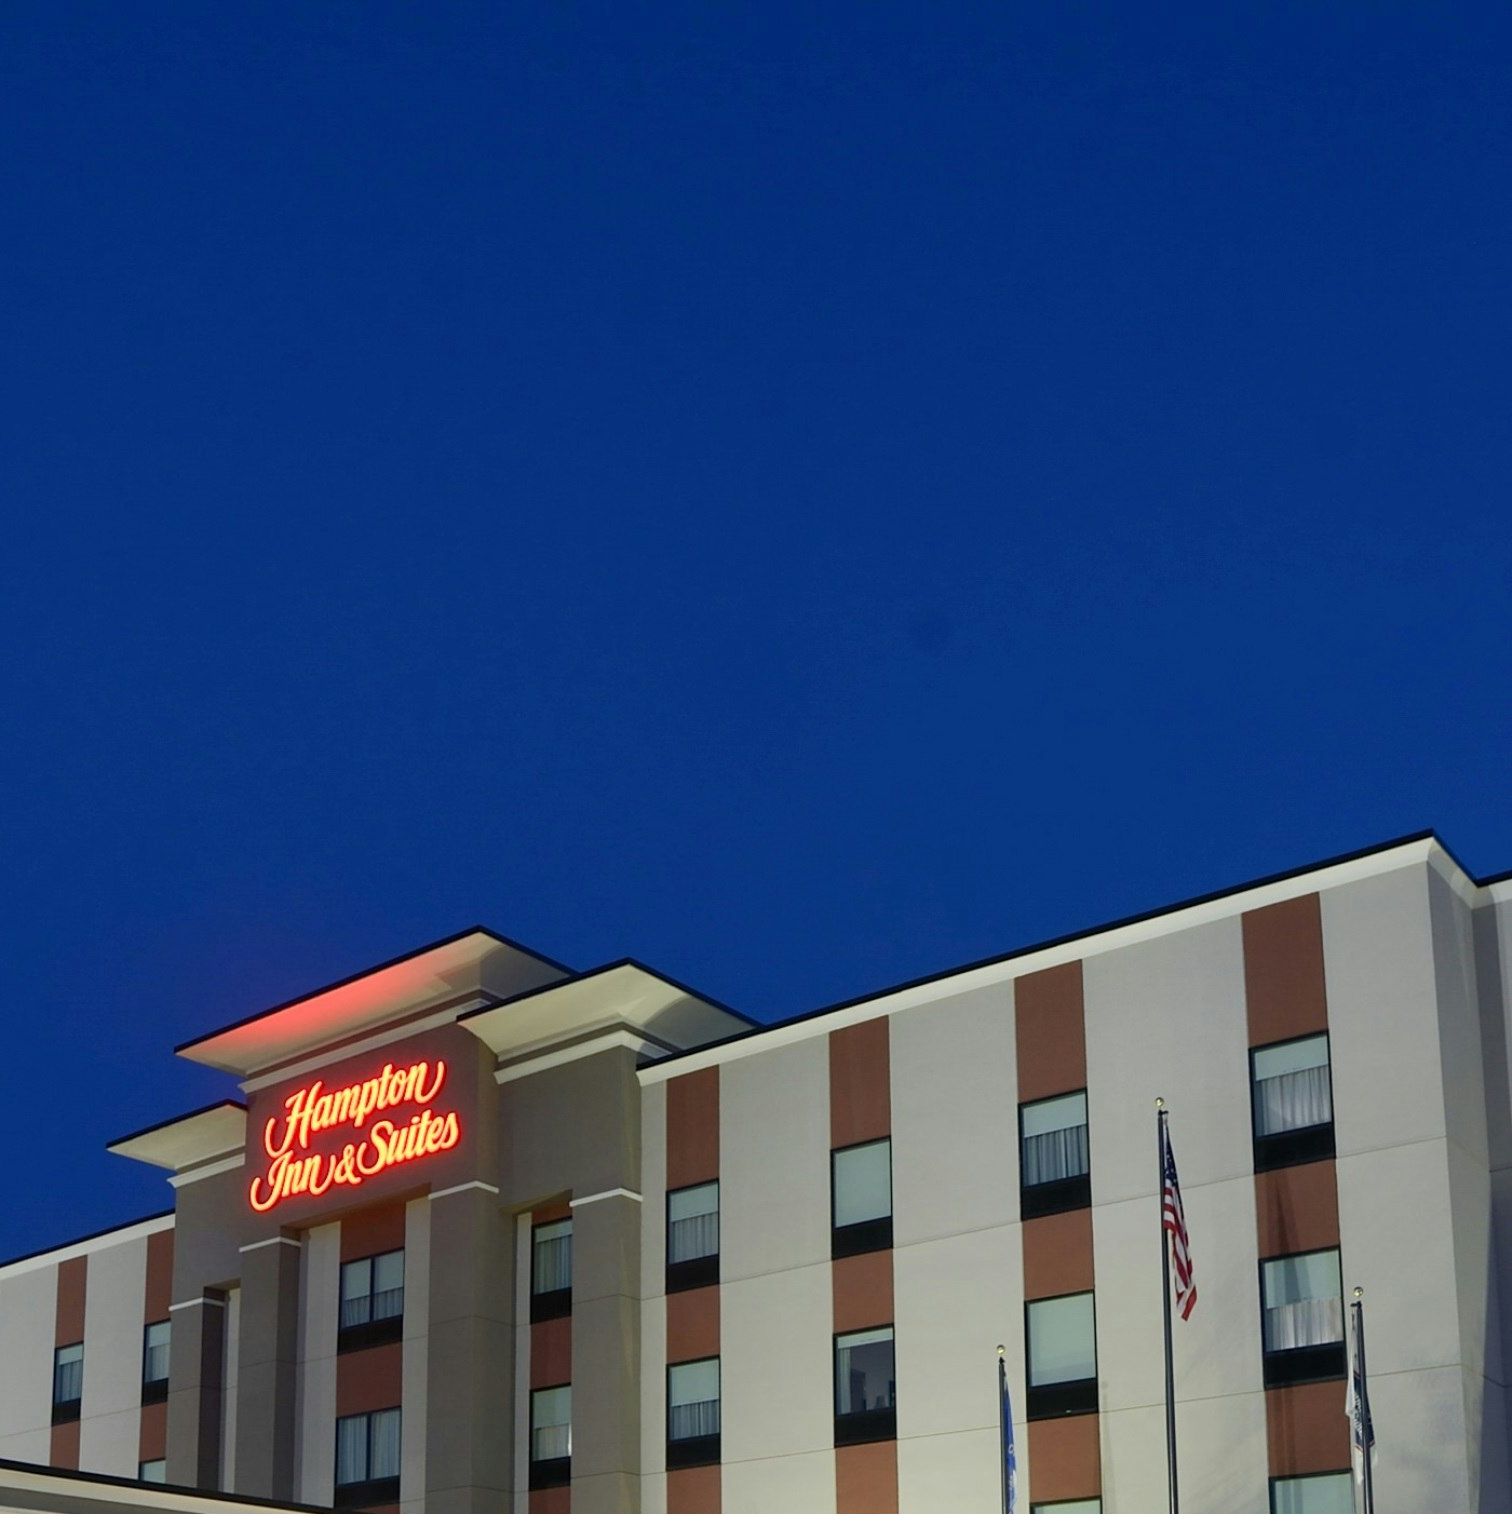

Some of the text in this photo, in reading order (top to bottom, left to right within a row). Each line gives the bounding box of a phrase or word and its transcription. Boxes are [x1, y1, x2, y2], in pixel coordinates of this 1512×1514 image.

[264, 1060, 445, 1158] Hampton
[250, 1109, 460, 1212] Inn & Suites
